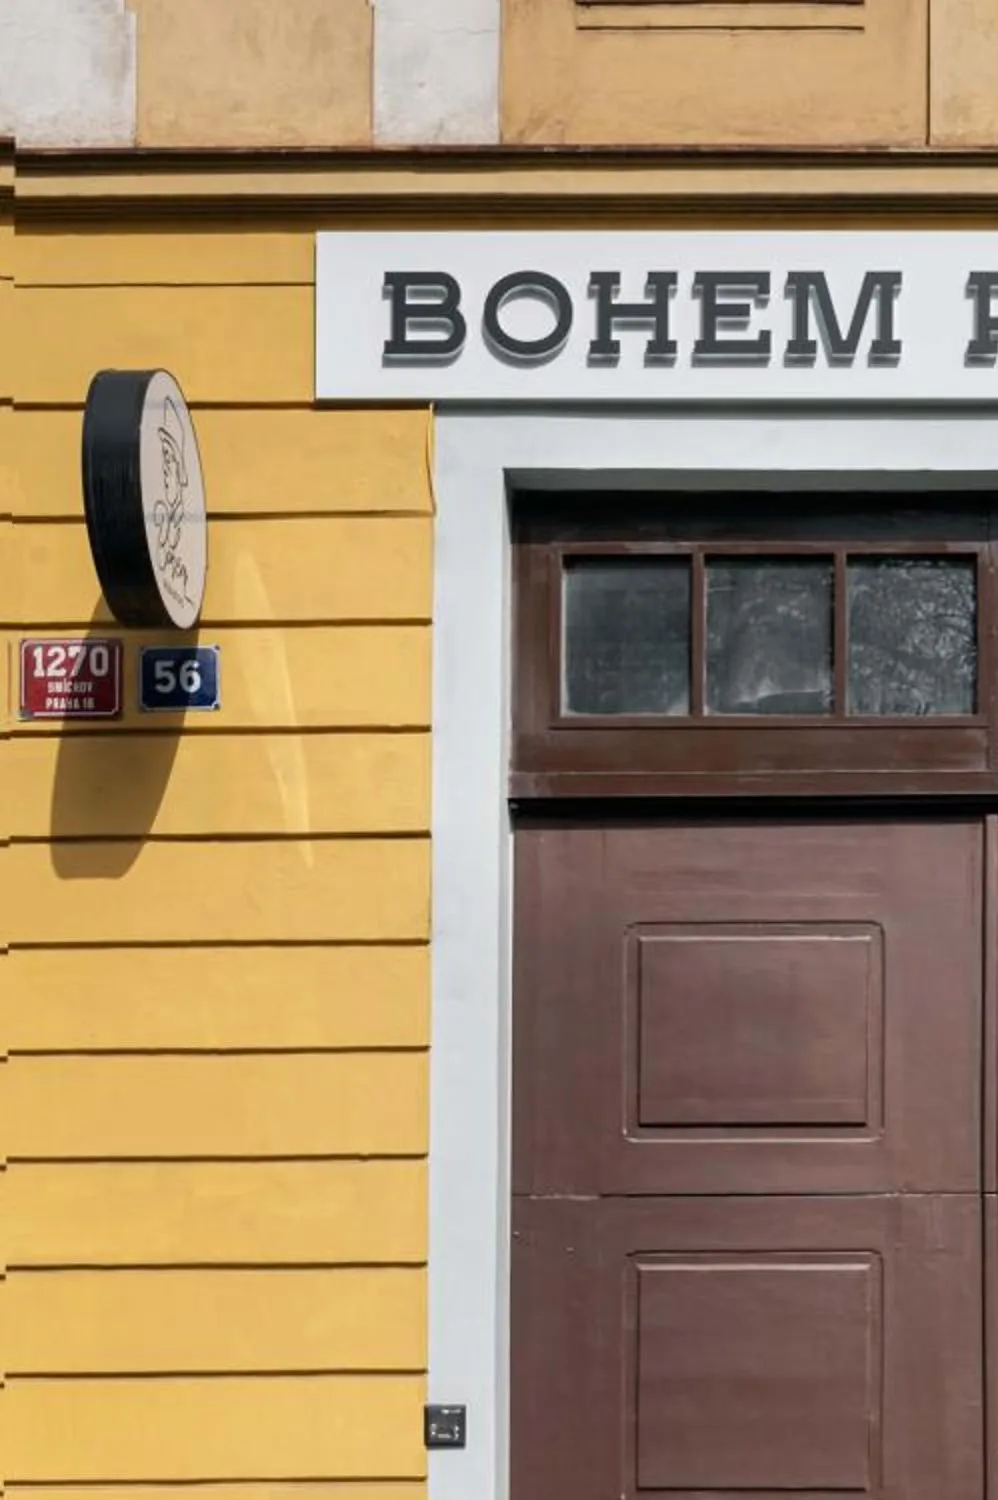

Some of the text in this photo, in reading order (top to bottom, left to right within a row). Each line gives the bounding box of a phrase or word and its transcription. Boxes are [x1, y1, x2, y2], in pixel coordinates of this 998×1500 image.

[382, 270, 902, 369] BOHEM
[33, 646, 109, 677] 1270
[154, 660, 202, 693] 56
